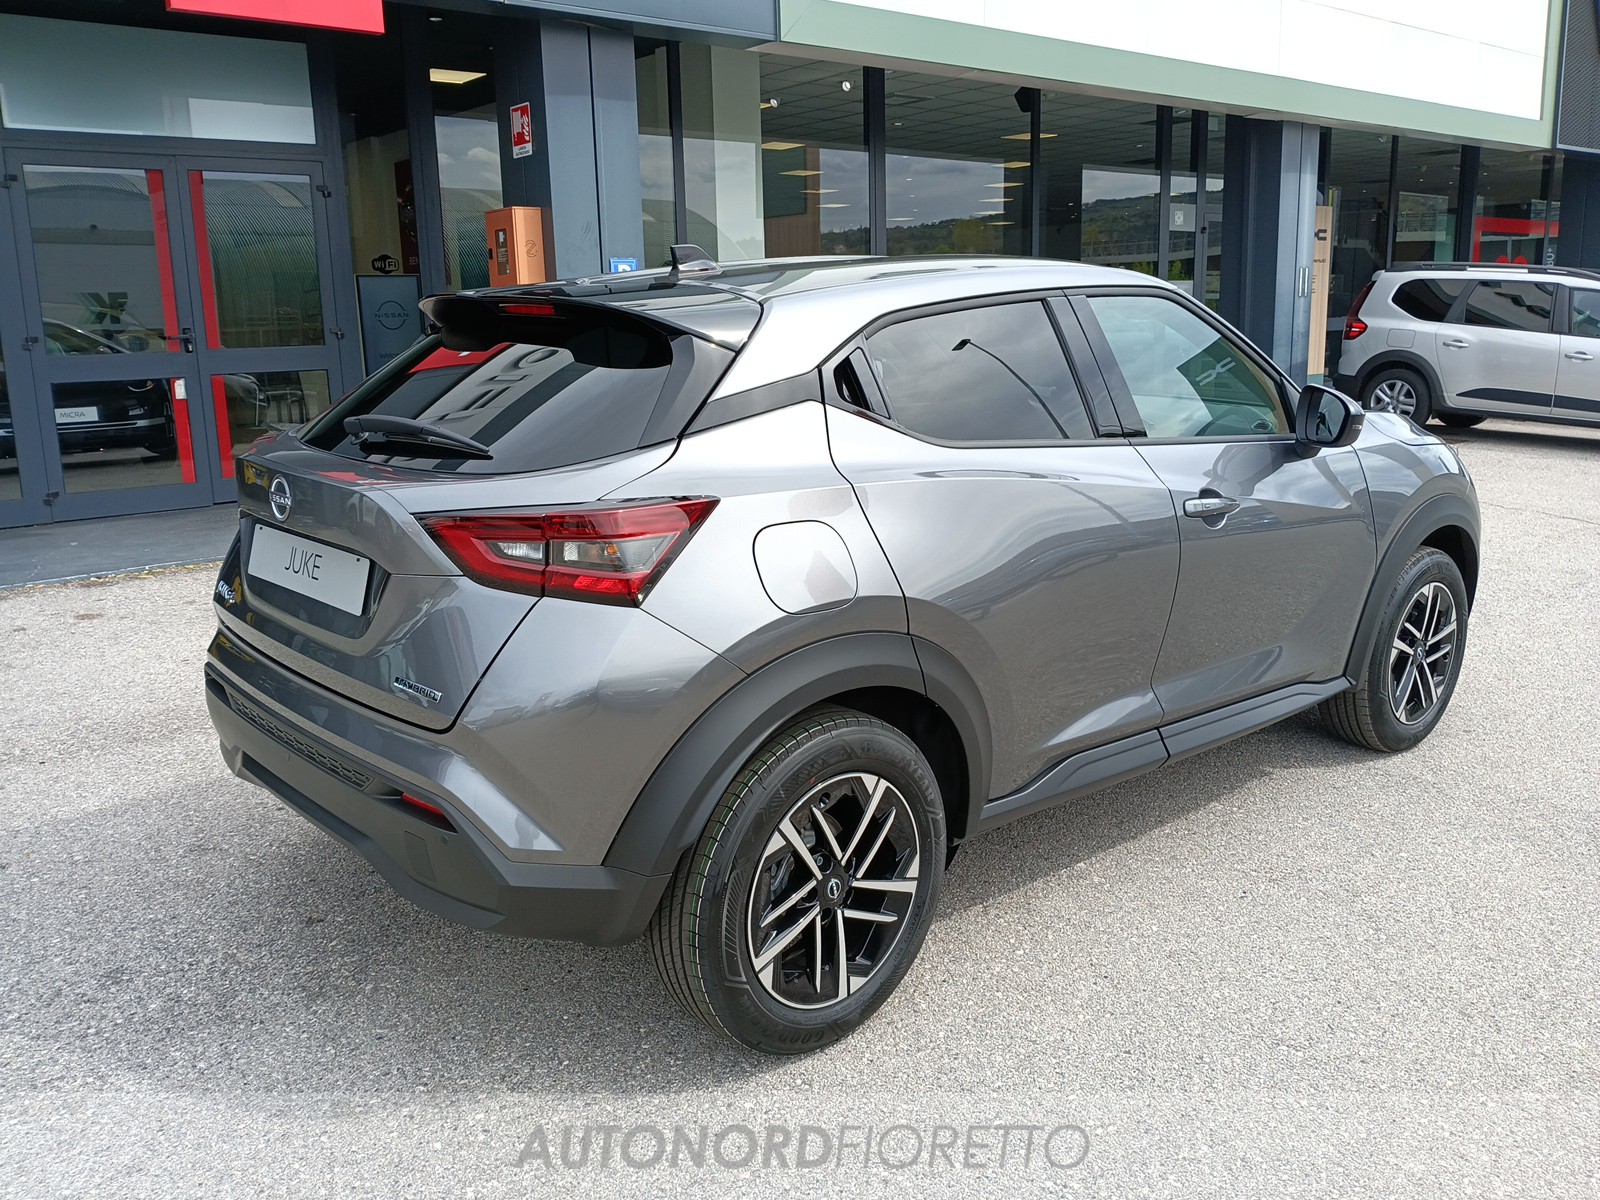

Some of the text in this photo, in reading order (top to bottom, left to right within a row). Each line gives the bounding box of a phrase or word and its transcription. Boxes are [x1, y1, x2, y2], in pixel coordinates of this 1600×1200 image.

[60, 411, 86, 419] MICRA
[269, 491, 292, 506] SSAN
[284, 546, 323, 581] JUKE
[395, 677, 440, 702] HYBRID
